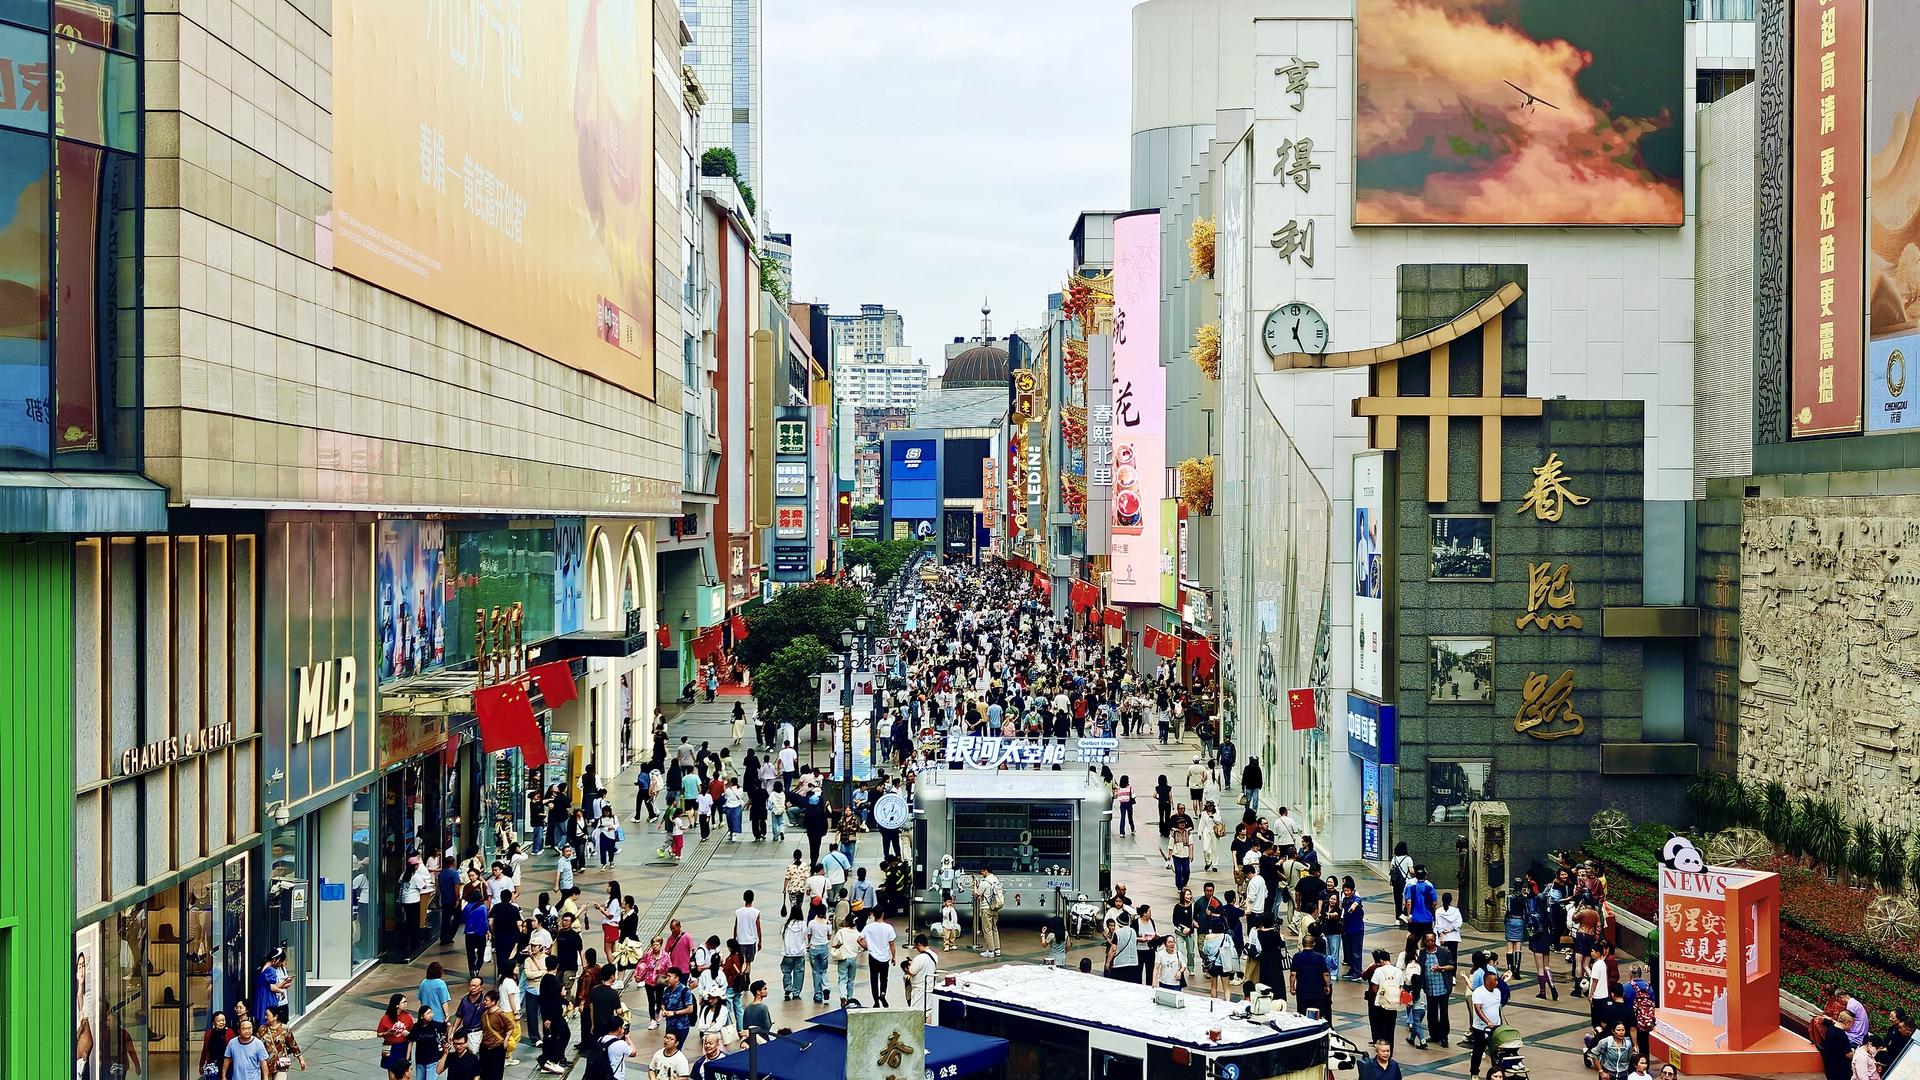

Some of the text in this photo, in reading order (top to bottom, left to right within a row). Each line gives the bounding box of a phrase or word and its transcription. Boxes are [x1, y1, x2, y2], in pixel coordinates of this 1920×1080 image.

[1270, 56, 1322, 269] 亨得利
[1092, 404, 1114, 486] 春熙北里
[1514, 452, 1591, 741] 春熙路
[296, 655, 356, 743] MLB
[121, 721, 232, 777] CHARLES & KEITH
[945, 736, 1066, 771] 银河太空舱
[1663, 870, 1727, 896] NEWS
[939, 1064, 958, 1079] 公安
